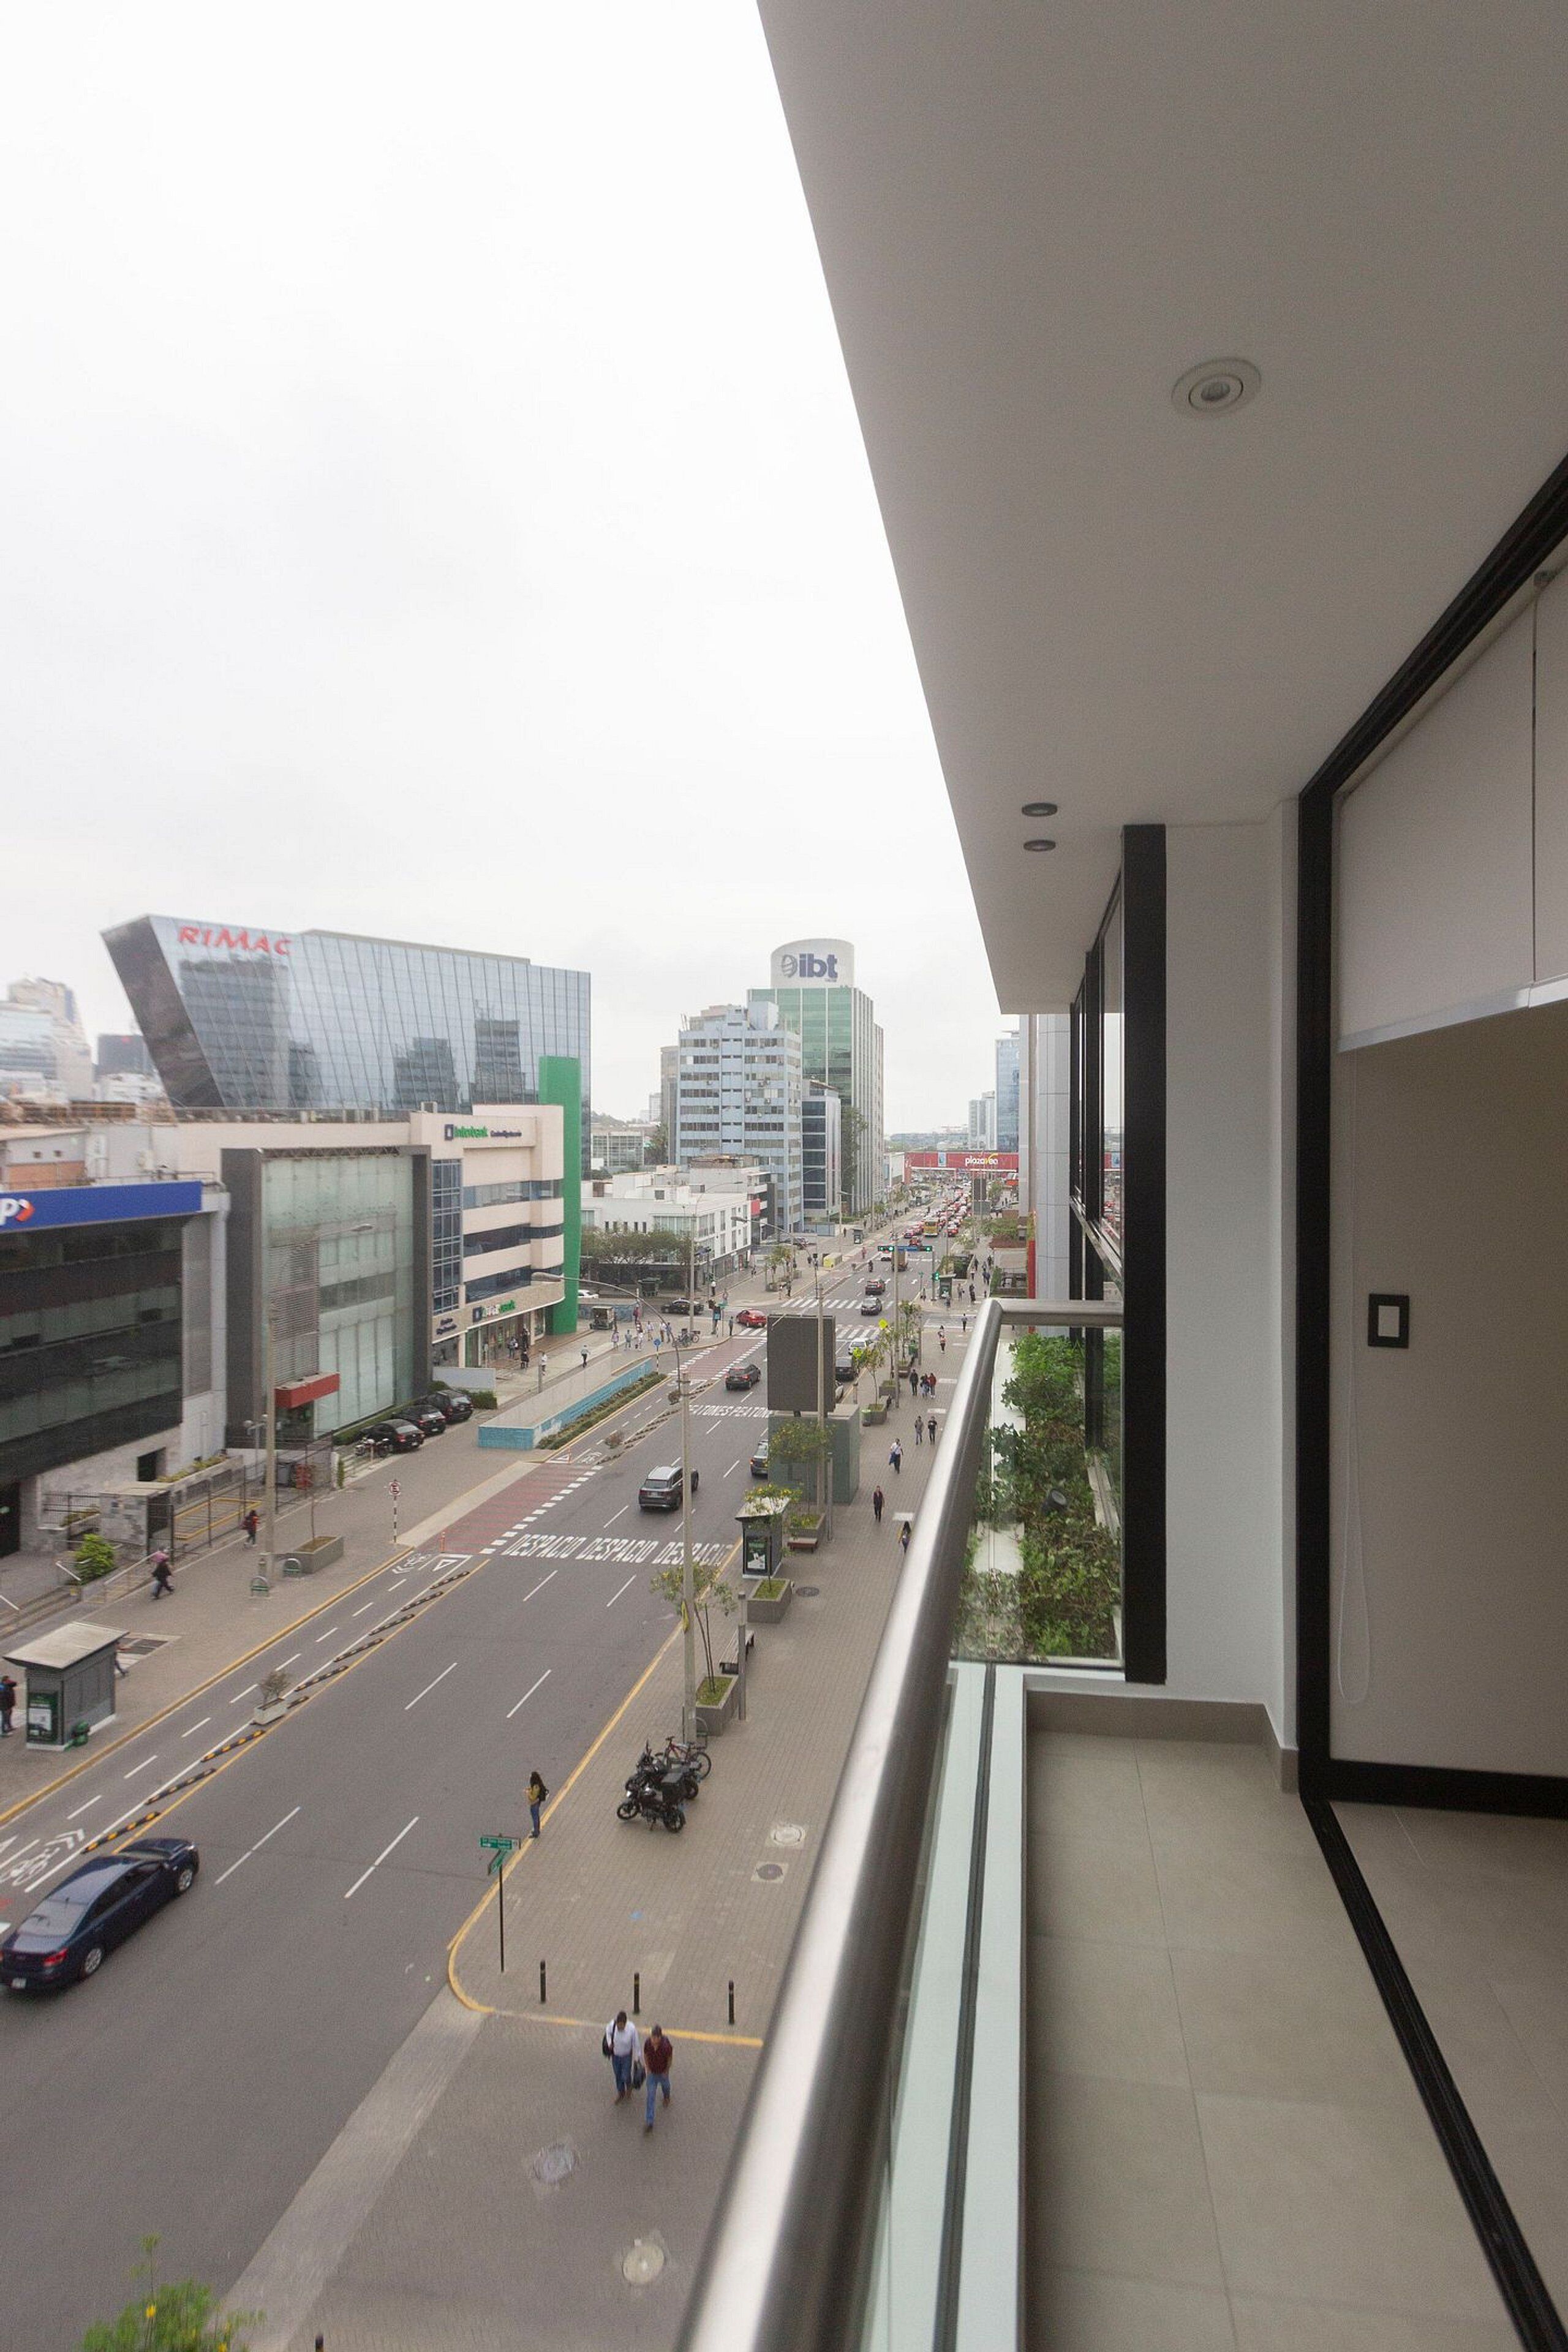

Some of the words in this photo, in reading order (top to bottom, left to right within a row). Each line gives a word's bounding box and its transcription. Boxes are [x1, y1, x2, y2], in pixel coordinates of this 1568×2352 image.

[177, 925, 292, 956] RIMAC
[799, 953, 837, 978] ibt
[501, 1534, 586, 1558] DESPACIO
[576, 1537, 658, 1562] DESPACIO
